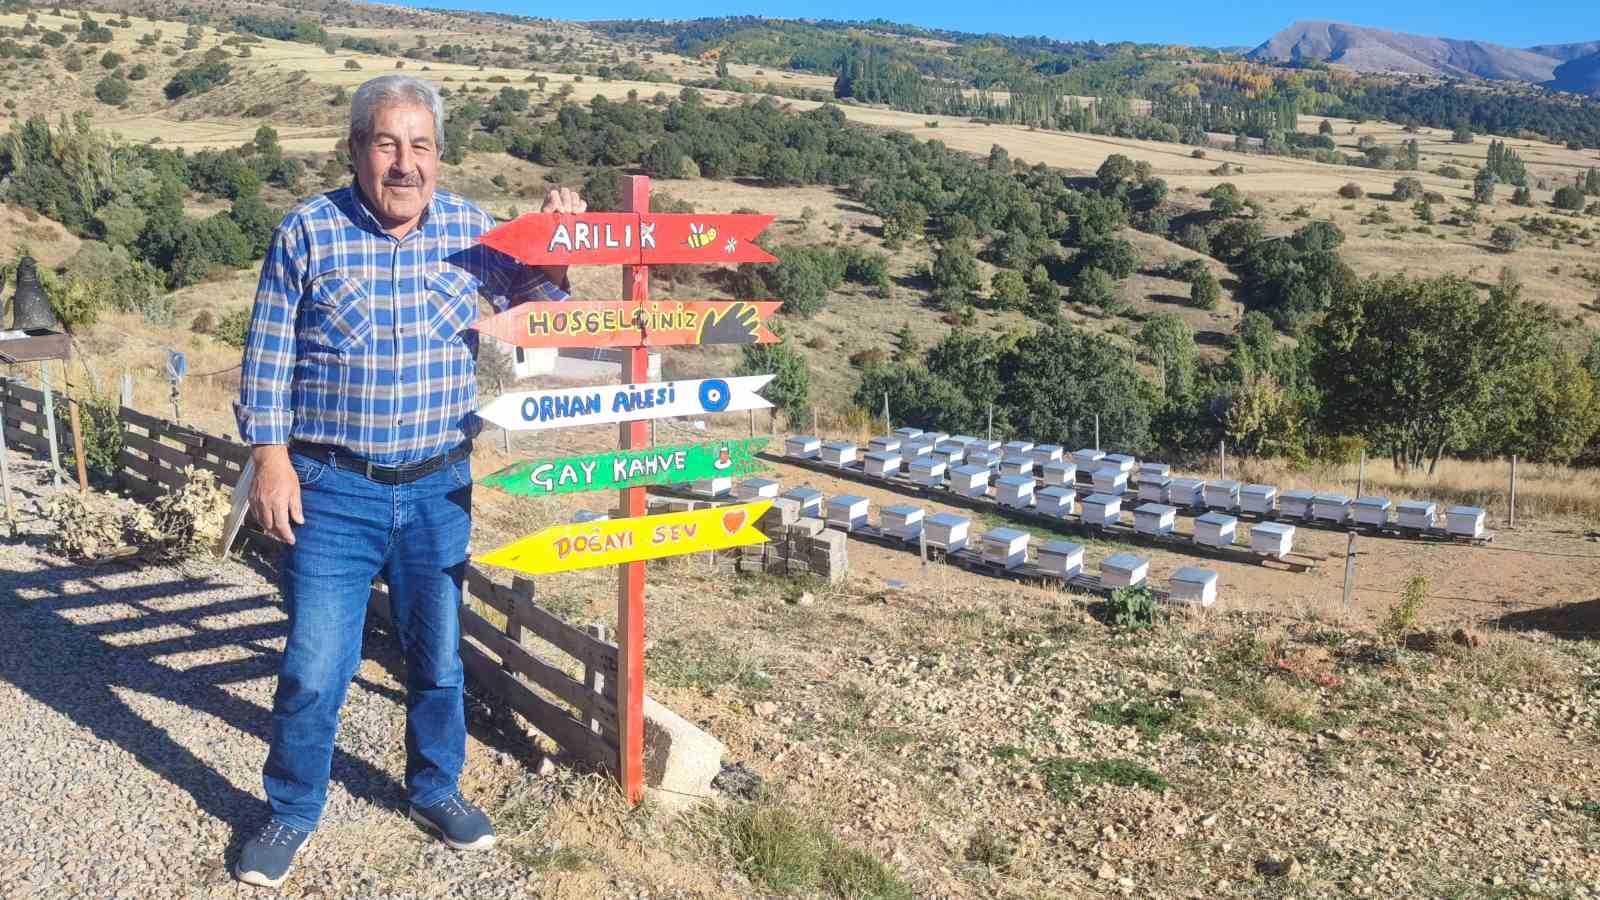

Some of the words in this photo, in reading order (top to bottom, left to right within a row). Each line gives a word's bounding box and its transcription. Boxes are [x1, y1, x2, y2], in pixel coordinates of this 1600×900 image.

[547, 222, 657, 252] ARILIK
[521, 393, 601, 422] ORHAN
[613, 451, 687, 482] KAHVE
[652, 523, 697, 545] SEV
